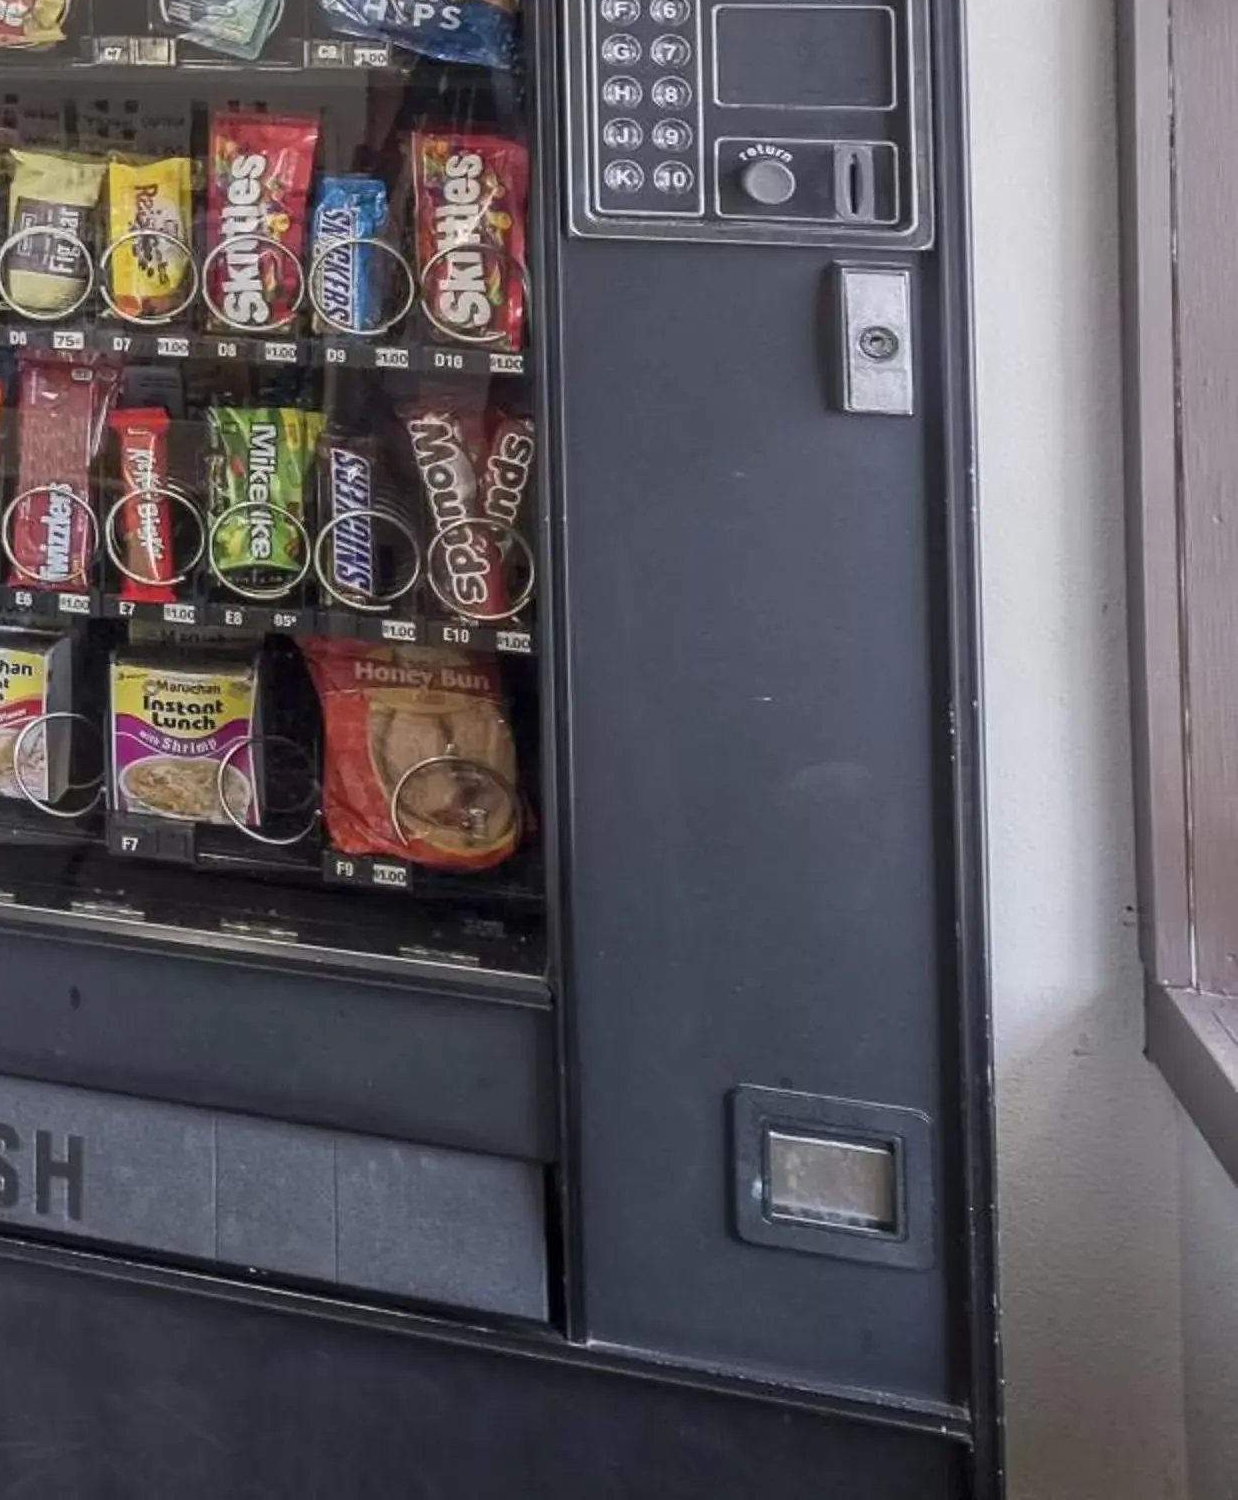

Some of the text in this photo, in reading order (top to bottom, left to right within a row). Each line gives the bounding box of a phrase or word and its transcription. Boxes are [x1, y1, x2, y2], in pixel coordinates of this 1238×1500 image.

[614, 1, 627, 17] F
[663, 1, 676, 18] 6
[613, 43, 629, 60] G
[664, 44, 677, 60] 7
[614, 86, 630, 102] H
[664, 86, 678, 103] 8
[616, 128, 630, 145] J
[665, 128, 679, 145] 9
[738, 143, 793, 163] return
[616, 170, 631, 185] K
[663, 170, 685, 187] 10
[49, 244, 82, 275] Fig
[318, 208, 354, 327] SNICKERS
[248, 420, 278, 501] Mike
[408, 419, 490, 605] Mounds
[329, 448, 374, 596] SNICKERS
[119, 602, 135, 615] E7
[225, 611, 243, 625] E8
[443, 627, 470, 643] E10
[354, 661, 490, 690] Honey Bun
[157, 679, 221, 695] Maruchan
[142, 695, 225, 715] Instant
[151, 712, 216, 731] Lunch
[138, 730, 217, 755] with Shrimp
[122, 837, 139, 851] F7
